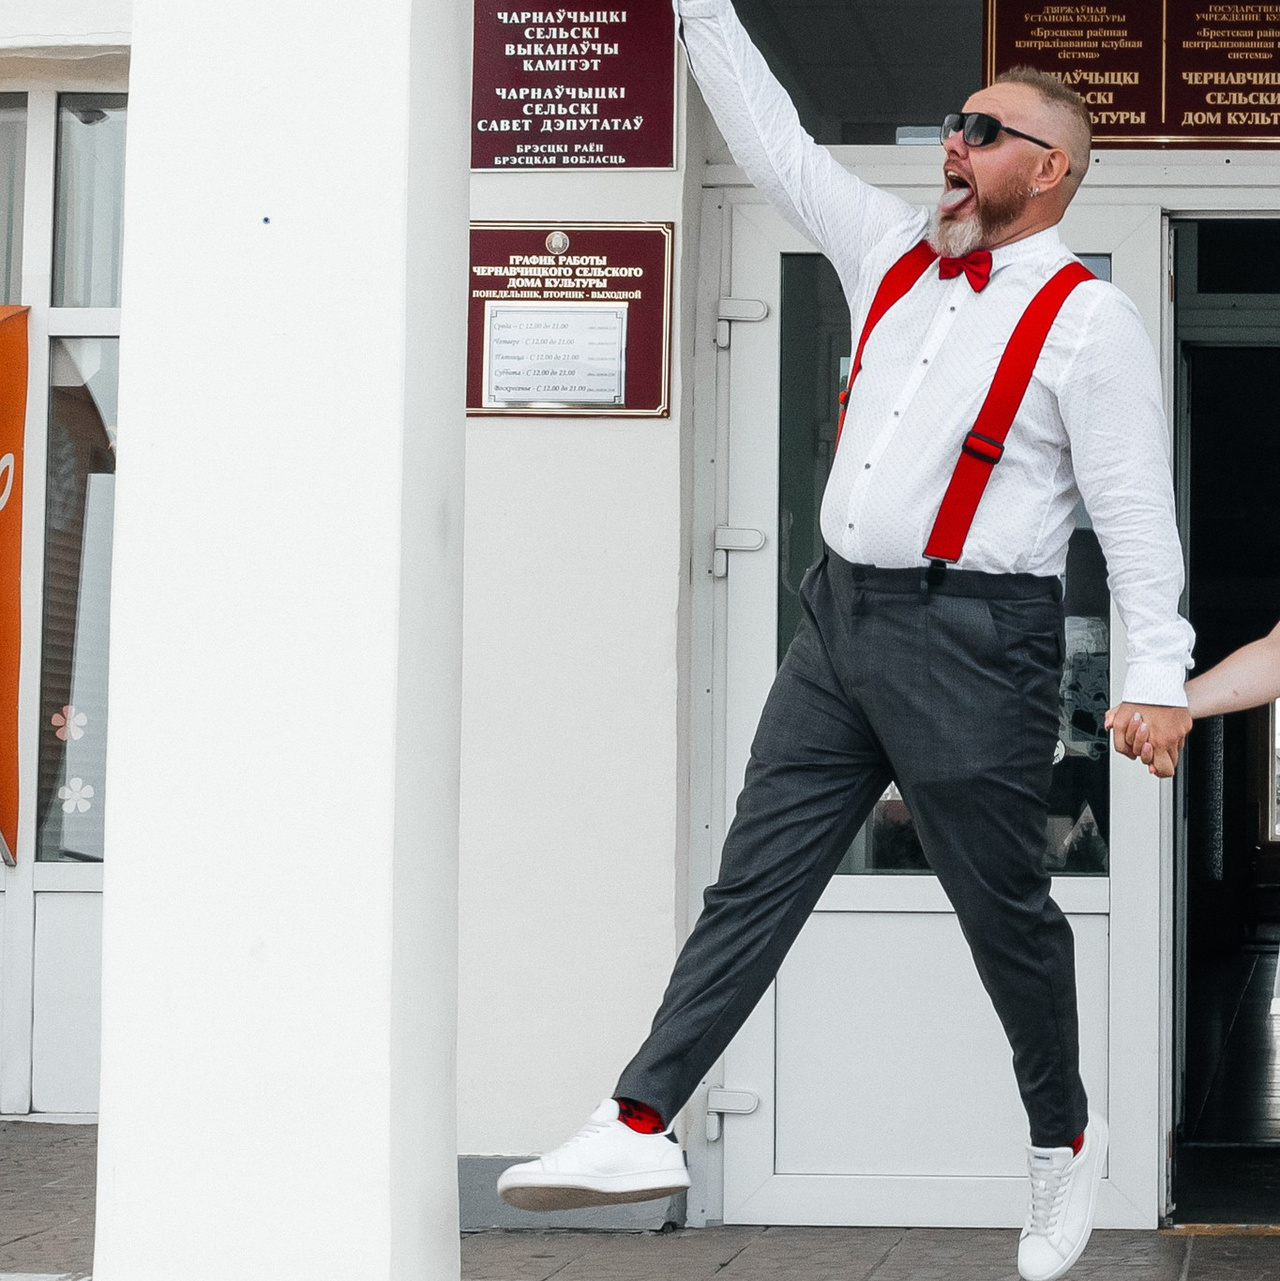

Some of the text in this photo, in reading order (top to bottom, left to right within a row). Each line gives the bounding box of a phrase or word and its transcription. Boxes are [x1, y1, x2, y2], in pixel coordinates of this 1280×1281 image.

[497, 9, 627, 24] ЧАРНАЎЧЫЦКІ
[524, 27, 600, 39] СЕЛЬСКІ
[505, 41, 619, 56] ВЫКАНАЎЧЫ
[1101, 39, 1143, 50] клубная
[523, 60, 601, 71] КАМІТЭТ
[496, 85, 625, 99] ЧАРНАЎЧЫЦКІ
[523, 104, 598, 115] СЕЛЬСКІ
[477, 116, 644, 132] САВЕТ ДЭПУТАТАЎ
[1181, 112, 1221, 126] ДОМ
[516, 143, 603, 154] БРЭСЦКІ РАЁН
[494, 156, 626, 165] БРЭСЦКАЯ ВОБЛАСЦЬ
[509, 255, 607, 265] ГРАФИК РАБОТЫ
[472, 266, 643, 277] ЧЕРНАВЧИЦКОГО СЕЛЬСКОГО
[507, 278, 607, 288] ДОМА КУЛЬТУРЫ
[472, 290, 541, 299] ПОНЕДЕЛЬНИК,
[543, 291, 584, 299] ВТОРНИК
[591, 290, 641, 299] ВЫХОДНОЙ
